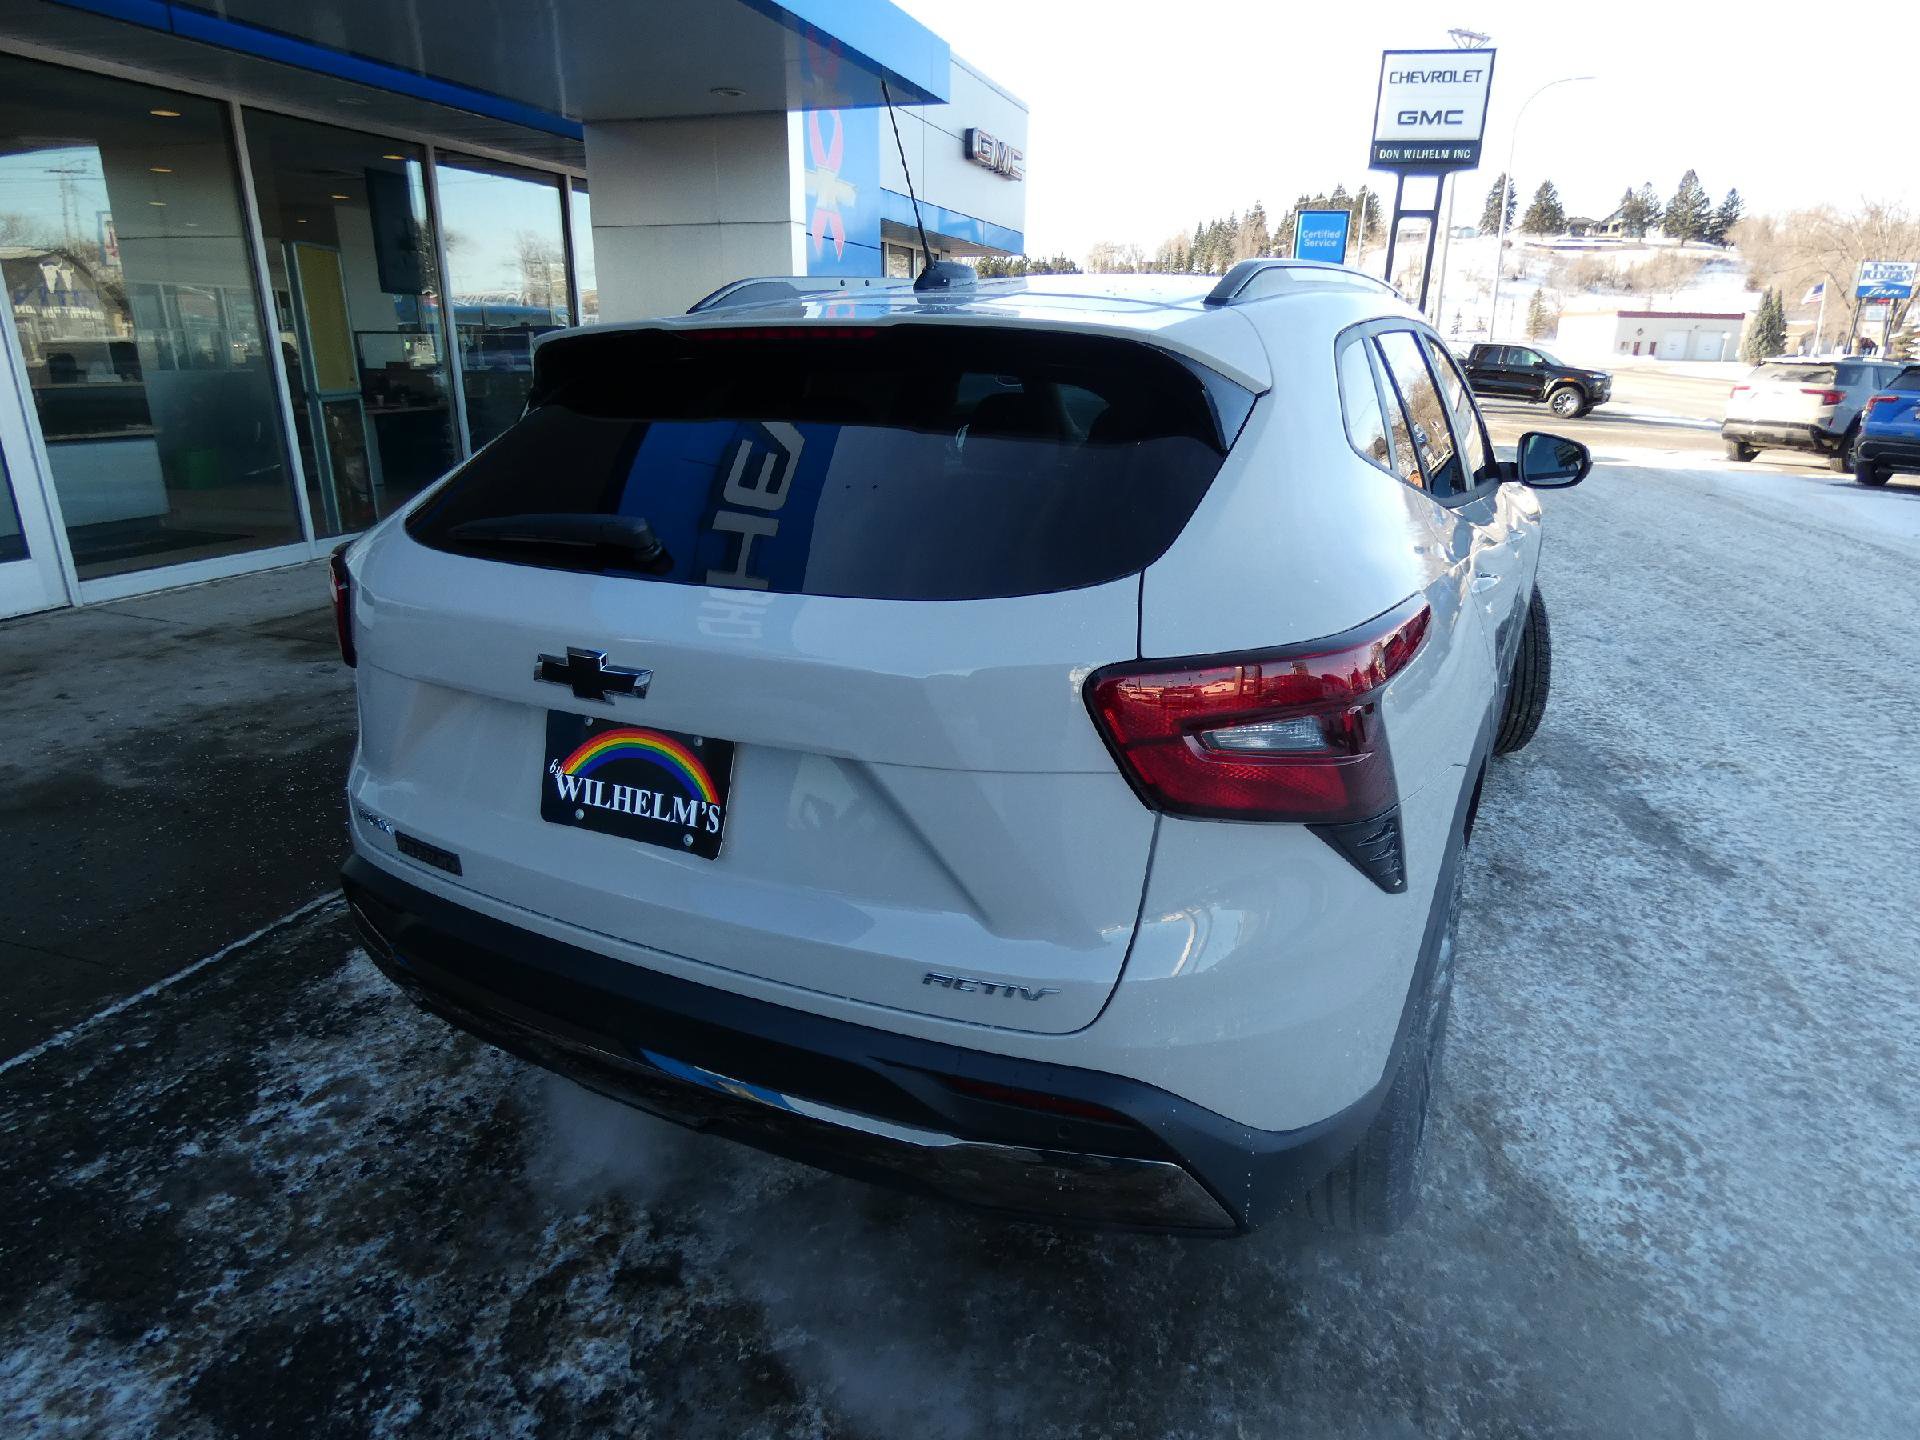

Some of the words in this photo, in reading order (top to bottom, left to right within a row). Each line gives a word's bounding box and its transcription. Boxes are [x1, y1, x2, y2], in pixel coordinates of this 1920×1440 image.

[1389, 69, 1483, 84] CHEVROLET
[1397, 109, 1464, 125] GMC
[965, 127, 1023, 181] GMC
[1379, 149, 1400, 159] DON
[1403, 149, 1450, 159] WILHELM
[1453, 149, 1471, 159] INC
[1302, 230, 1341, 239] Certified
[1303, 239, 1337, 247] Service
[555, 774, 721, 834] WILHELM'S
[922, 971, 1061, 1001] ACTIV
